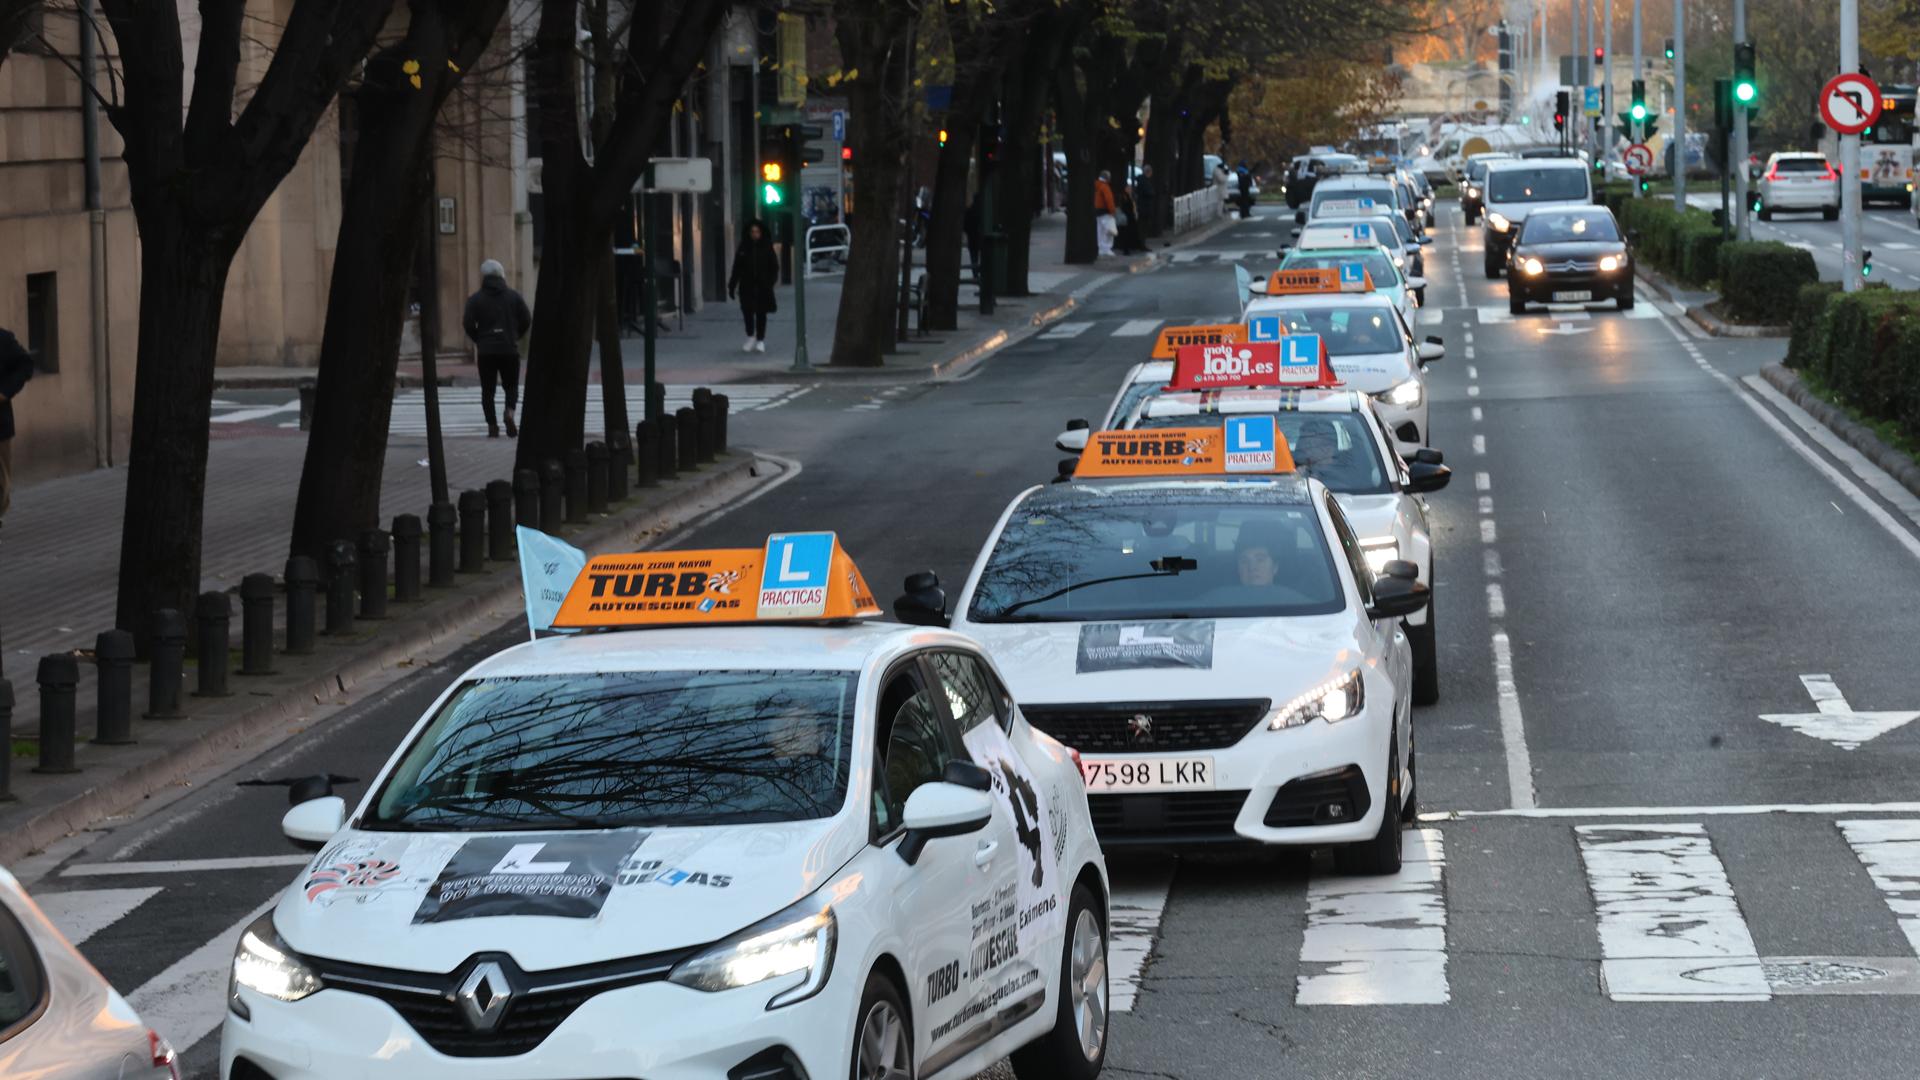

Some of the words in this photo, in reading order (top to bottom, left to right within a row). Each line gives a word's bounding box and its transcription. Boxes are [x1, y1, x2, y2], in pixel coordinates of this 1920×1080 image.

[1345, 266, 1358, 280] L
[1256, 320, 1271, 338] L
[1203, 345, 1233, 355] moto
[1289, 340, 1308, 363] L
[1281, 365, 1318, 377] PRACTICAS
[1238, 422, 1262, 449] L
[1227, 452, 1272, 465] PRACTICAS
[647, 561, 675, 570] ZIZUR
[678, 559, 712, 568] MAYOR
[778, 542, 810, 583] L
[761, 588, 822, 606] PRACTICAS
[1087, 762, 1150, 787] 7598
[1159, 761, 1206, 785] LKR
[490, 842, 572, 874] L
[927, 957, 960, 1008] TURBO
